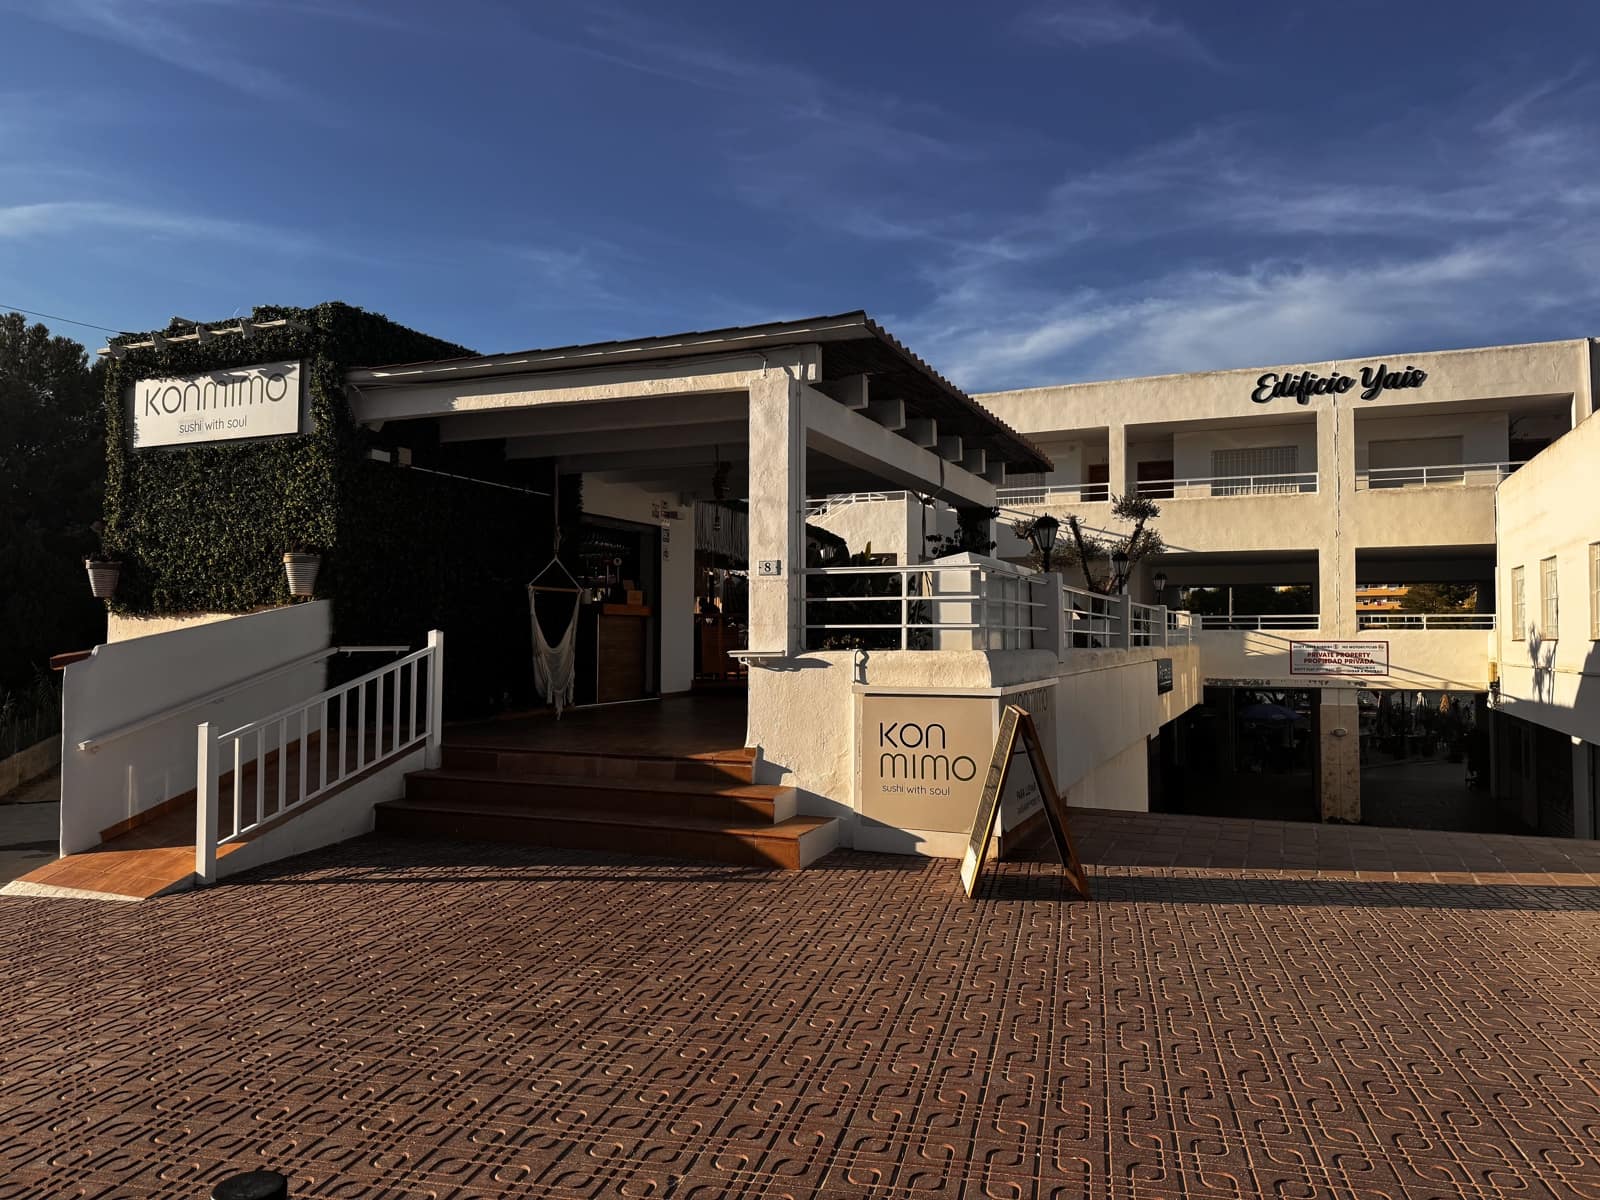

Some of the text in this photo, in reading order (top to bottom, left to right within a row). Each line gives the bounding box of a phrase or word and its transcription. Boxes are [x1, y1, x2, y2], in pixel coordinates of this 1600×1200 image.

[1251, 370, 1357, 405] Edificio
[179, 415, 247, 434] sushi with soul
[764, 562, 771, 572] 8
[882, 783, 951, 797] sushi with soul
